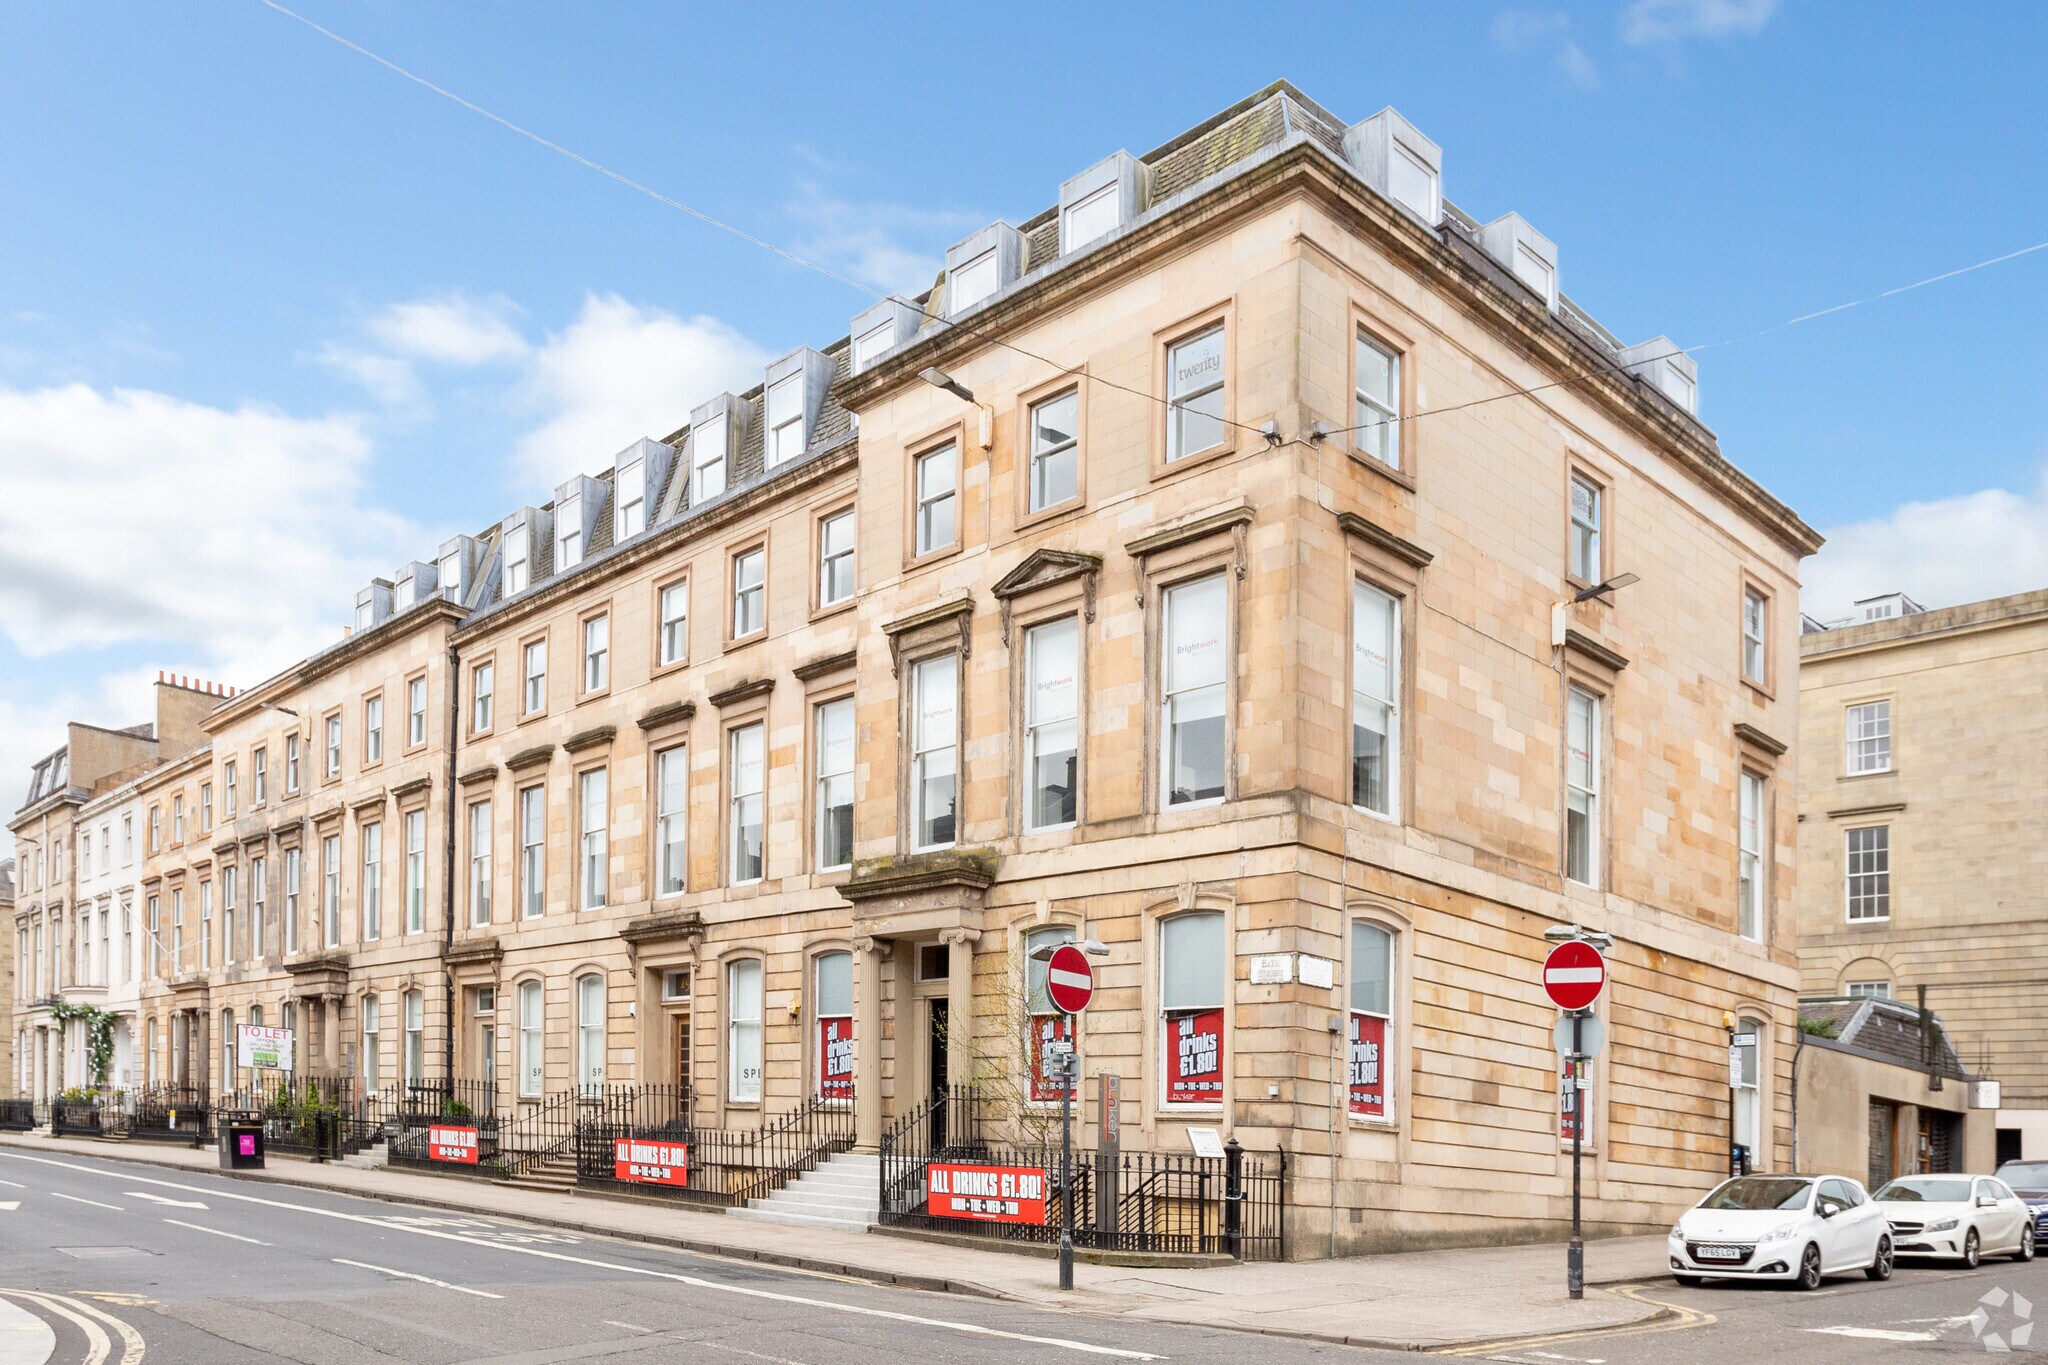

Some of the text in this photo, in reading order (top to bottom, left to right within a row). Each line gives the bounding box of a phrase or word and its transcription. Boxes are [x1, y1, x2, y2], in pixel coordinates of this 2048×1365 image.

[1178, 354, 1220, 381] twenty
[1176, 638, 1217, 655] Brightwork
[1355, 642, 1388, 665] Brightwork
[1037, 675, 1073, 691] Brightwork
[243, 1026, 289, 1039] TO LET
[827, 1022, 838, 1041] all
[1179, 1014, 1194, 1036] all
[827, 1037, 852, 1058] drinks
[1179, 1031, 1217, 1056] drinks
[1180, 1051, 1217, 1077] £1.80!
[1108, 1077, 1119, 1143] bunker
[430, 1129, 439, 1145] ALL
[439, 1130, 459, 1146] DRINKS
[617, 1143, 685, 1167] ALL DRINKS £1.80!
[930, 1169, 1042, 1200] ALL DRINKS £1.80!
